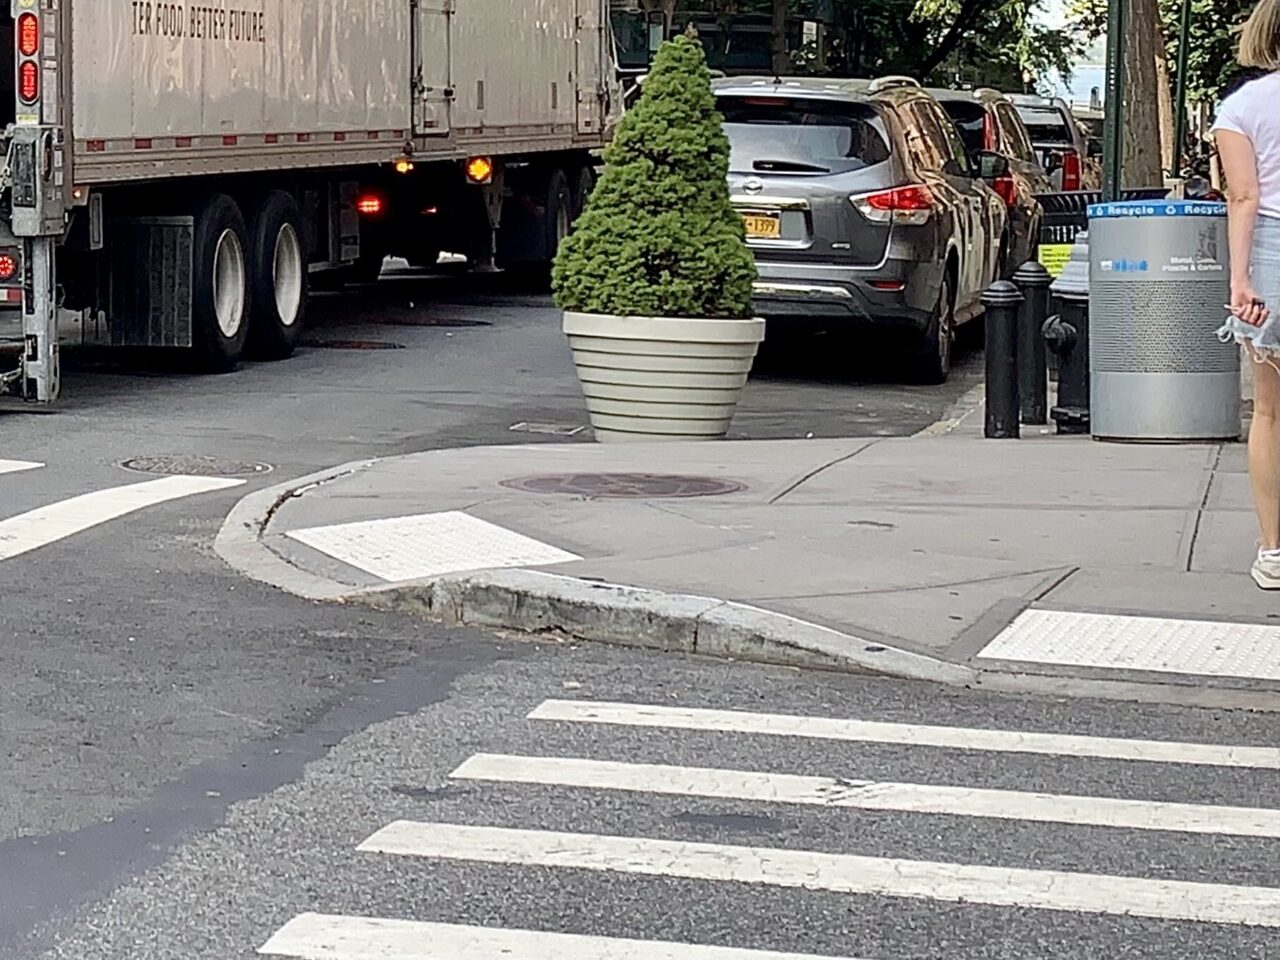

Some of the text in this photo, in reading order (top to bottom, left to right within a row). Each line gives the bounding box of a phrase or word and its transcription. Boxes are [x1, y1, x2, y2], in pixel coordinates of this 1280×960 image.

[156, 2, 186, 37] FOOD.
[190, 6, 225, 39] BETTER
[1107, 205, 1154, 216] Recycle
